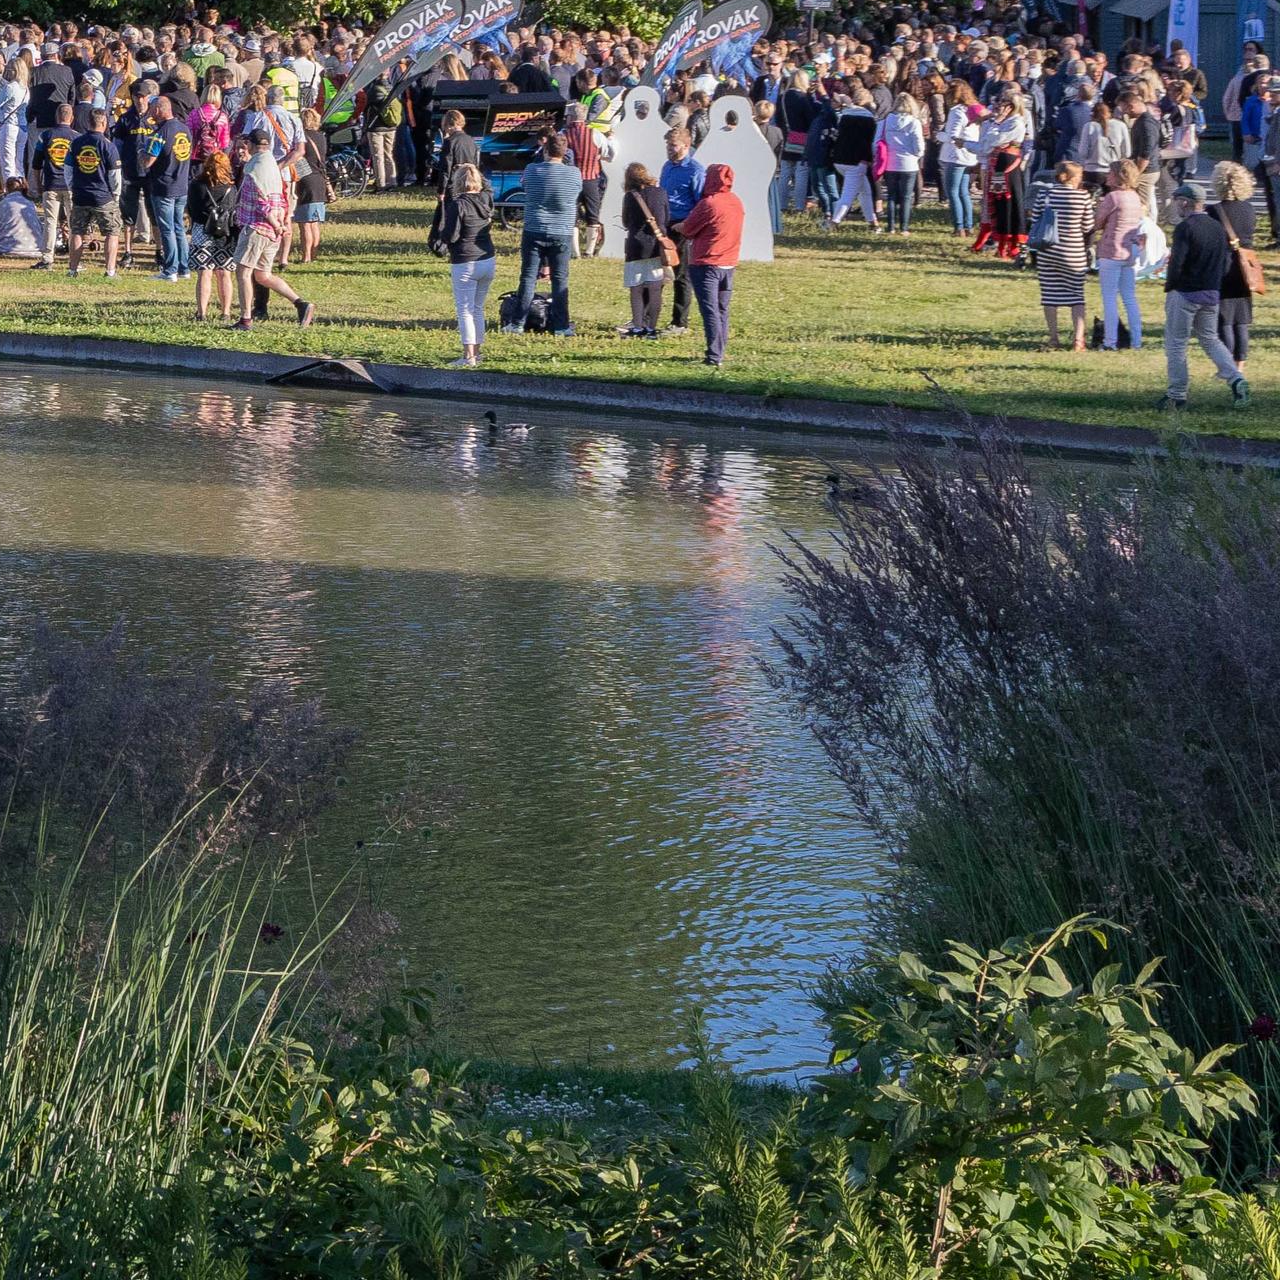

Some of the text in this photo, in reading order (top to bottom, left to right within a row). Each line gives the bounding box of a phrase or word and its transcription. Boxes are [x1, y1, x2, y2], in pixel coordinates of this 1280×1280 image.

[654, 9, 698, 68] PROVÅK
[694, 5, 760, 48] ROVÅK
[495, 109, 559, 121] PROVÅK
